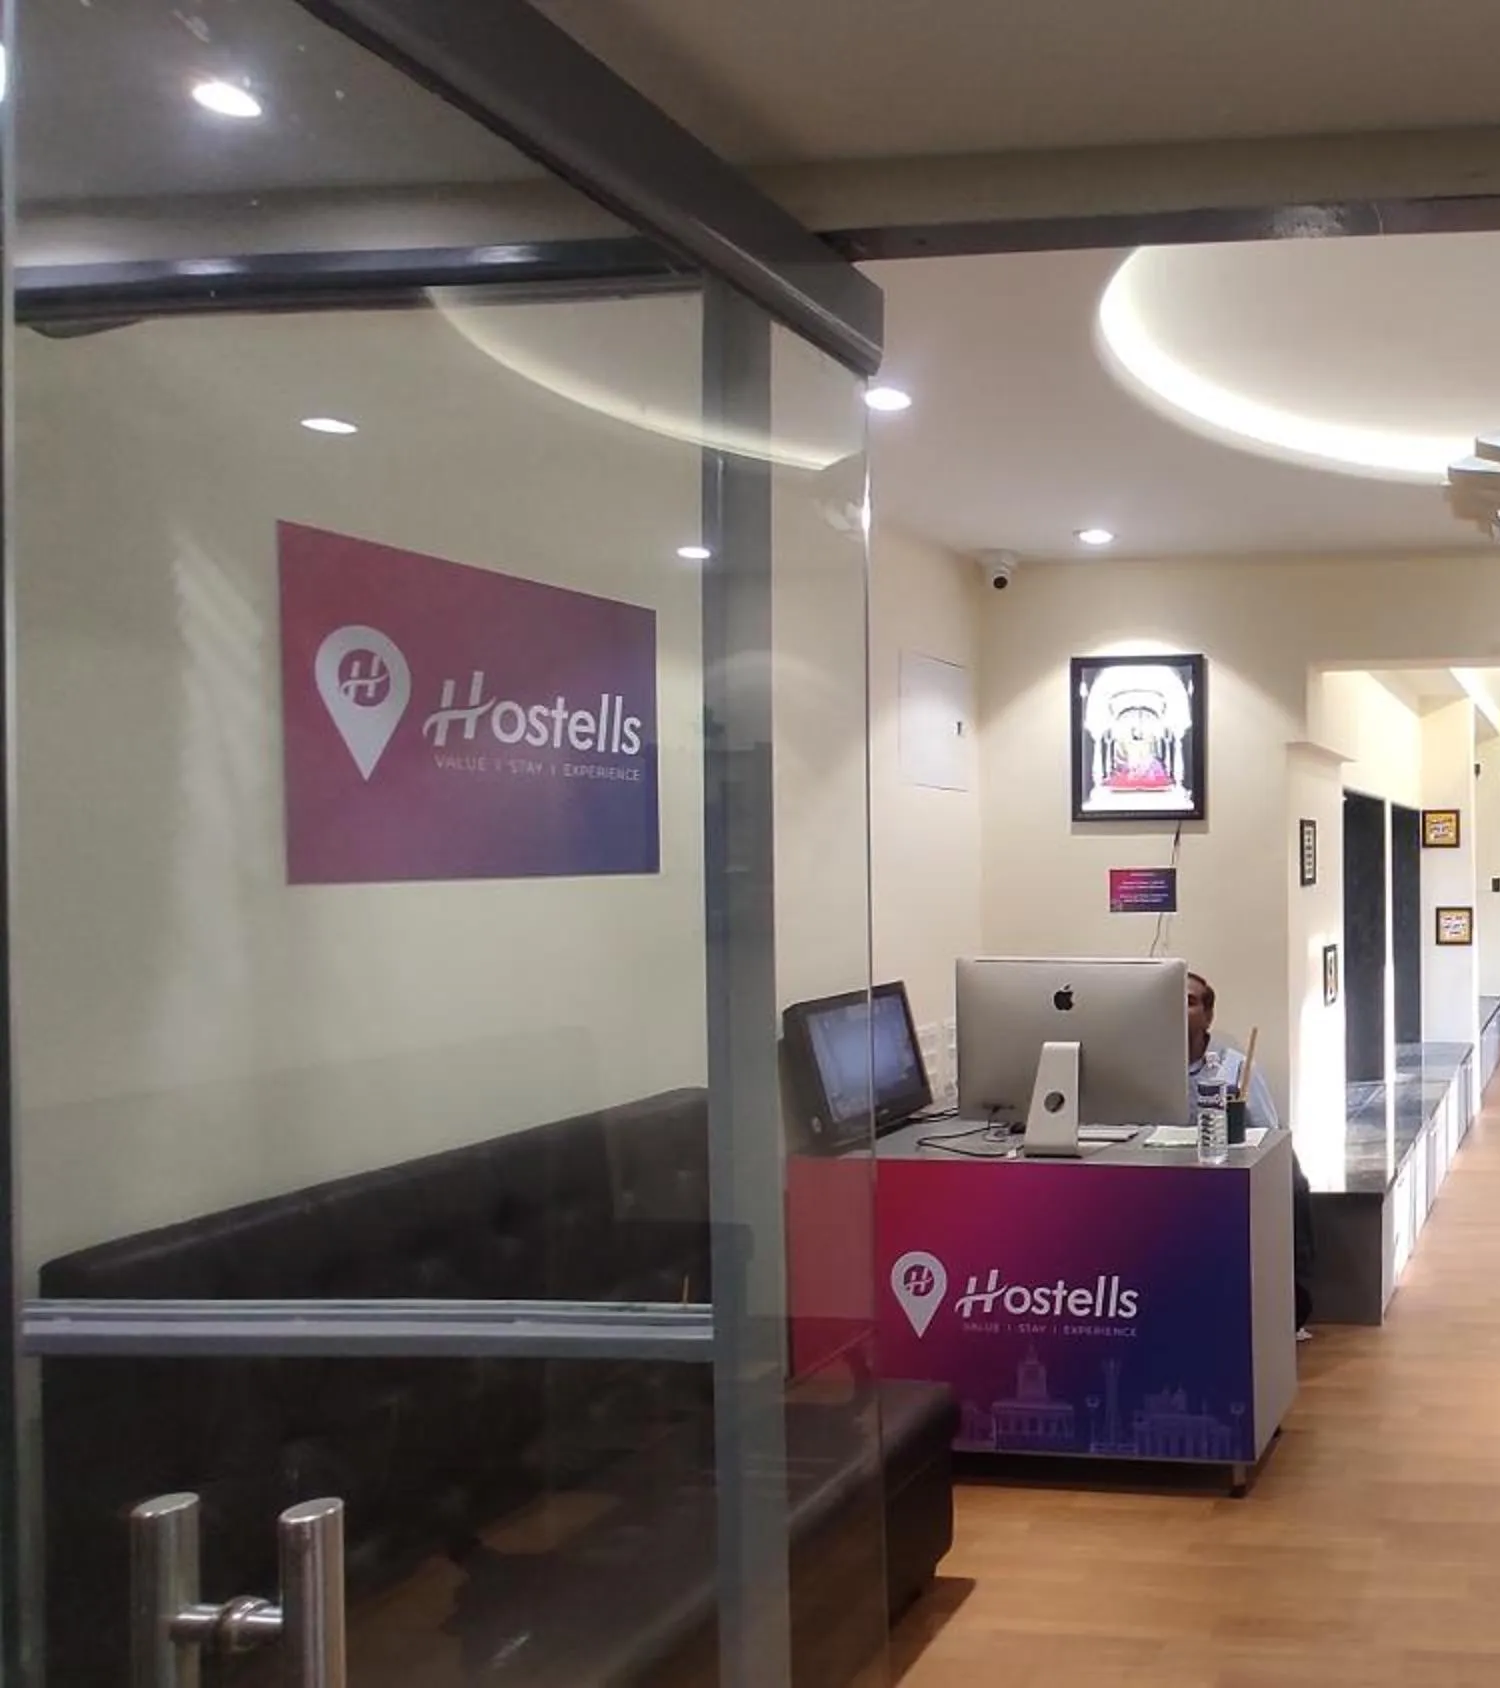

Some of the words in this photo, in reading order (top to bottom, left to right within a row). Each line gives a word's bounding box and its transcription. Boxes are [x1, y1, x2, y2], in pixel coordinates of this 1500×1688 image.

[422, 671, 641, 755] Hostells
[434, 754, 485, 772] VALUE
[510, 757, 543, 774] STAY
[563, 762, 641, 782] EXPERIENCE
[954, 1269, 1139, 1318] Hostells
[962, 1321, 999, 1333] VALUE
[1018, 1322, 1047, 1334] STAY
[1063, 1324, 1137, 1337] EXPERIENCE
